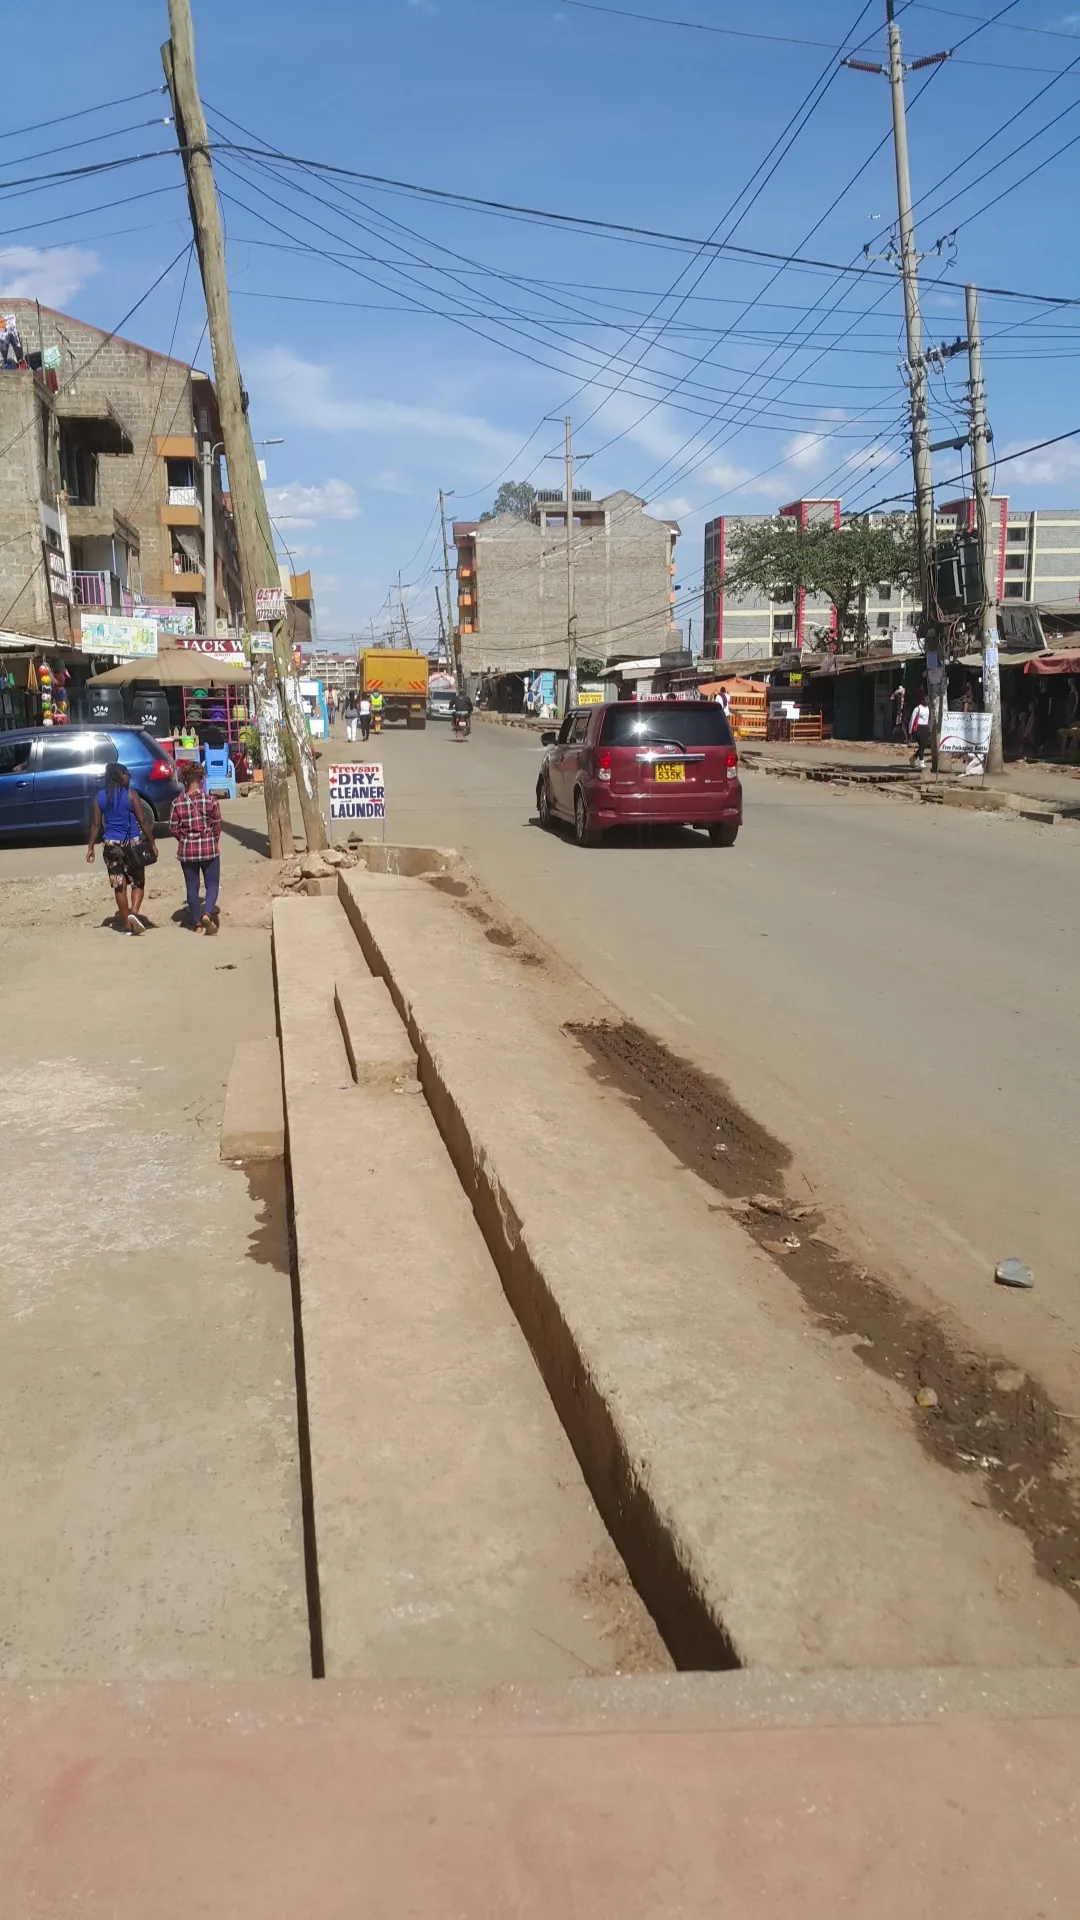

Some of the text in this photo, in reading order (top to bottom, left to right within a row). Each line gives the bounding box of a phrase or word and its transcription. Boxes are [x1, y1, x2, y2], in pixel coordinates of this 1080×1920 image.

[182, 640, 228, 652] JACK
[92, 705, 109, 713] STAR
[140, 714, 158, 722] STAR
[951, 744, 974, 752] Packaging
[657, 762, 676, 772] KCE
[658, 771, 682, 780] 535K
[330, 786, 385, 800] CLEANER
[331, 802, 386, 819] LAUNDRY
